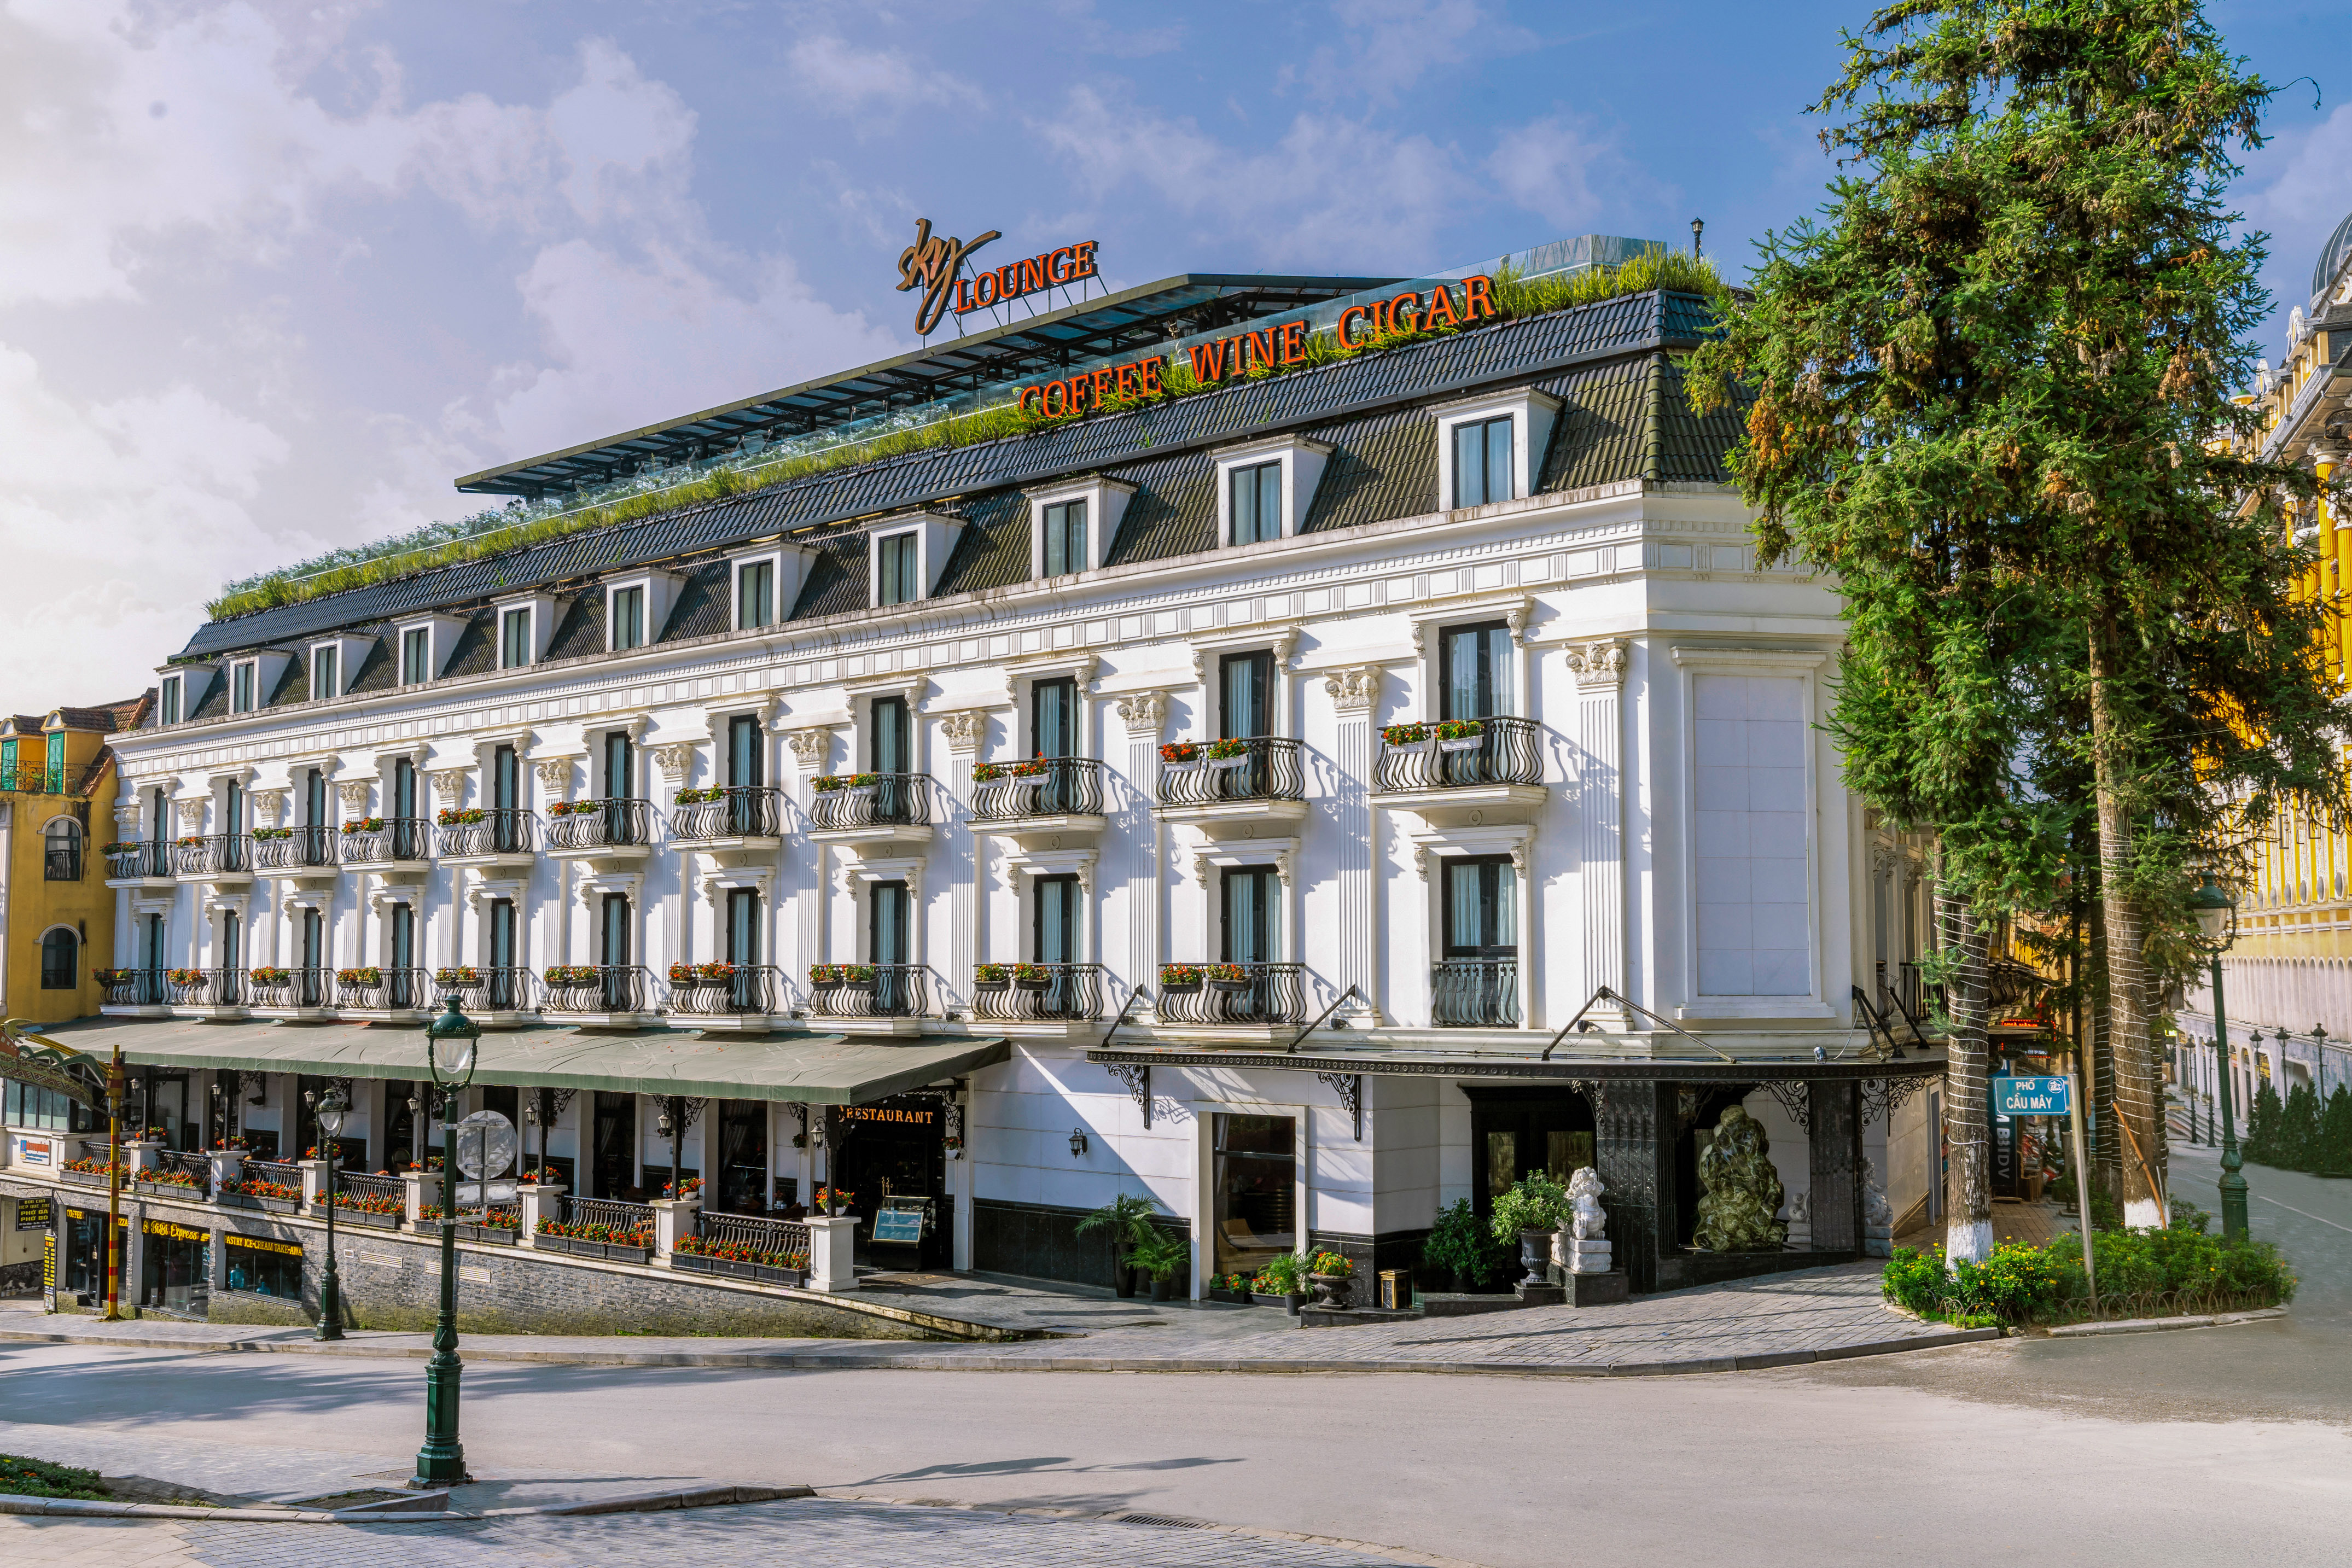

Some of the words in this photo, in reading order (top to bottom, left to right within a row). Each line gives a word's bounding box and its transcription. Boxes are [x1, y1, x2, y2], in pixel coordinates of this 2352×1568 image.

[954, 240, 1099, 314] LOUNGE
[1019, 354, 1167, 422] COFFEE
[1187, 319, 1310, 383] WINE
[1338, 275, 1495, 350] CIGAR
[2016, 1079, 2035, 1091] PHỐ
[2006, 1093, 2028, 1109] CẦU
[2030, 1094, 2052, 1109] MÂY
[846, 1107, 933, 1124] RESTAURANT
[66, 1209, 84, 1219] COFFEE
[171, 1224, 198, 1240] Express
[224, 1235, 243, 1246] PASTRY
[244, 1238, 273, 1251] ICE-CREAM
[274, 1243, 303, 1256] TAKE-AWA
